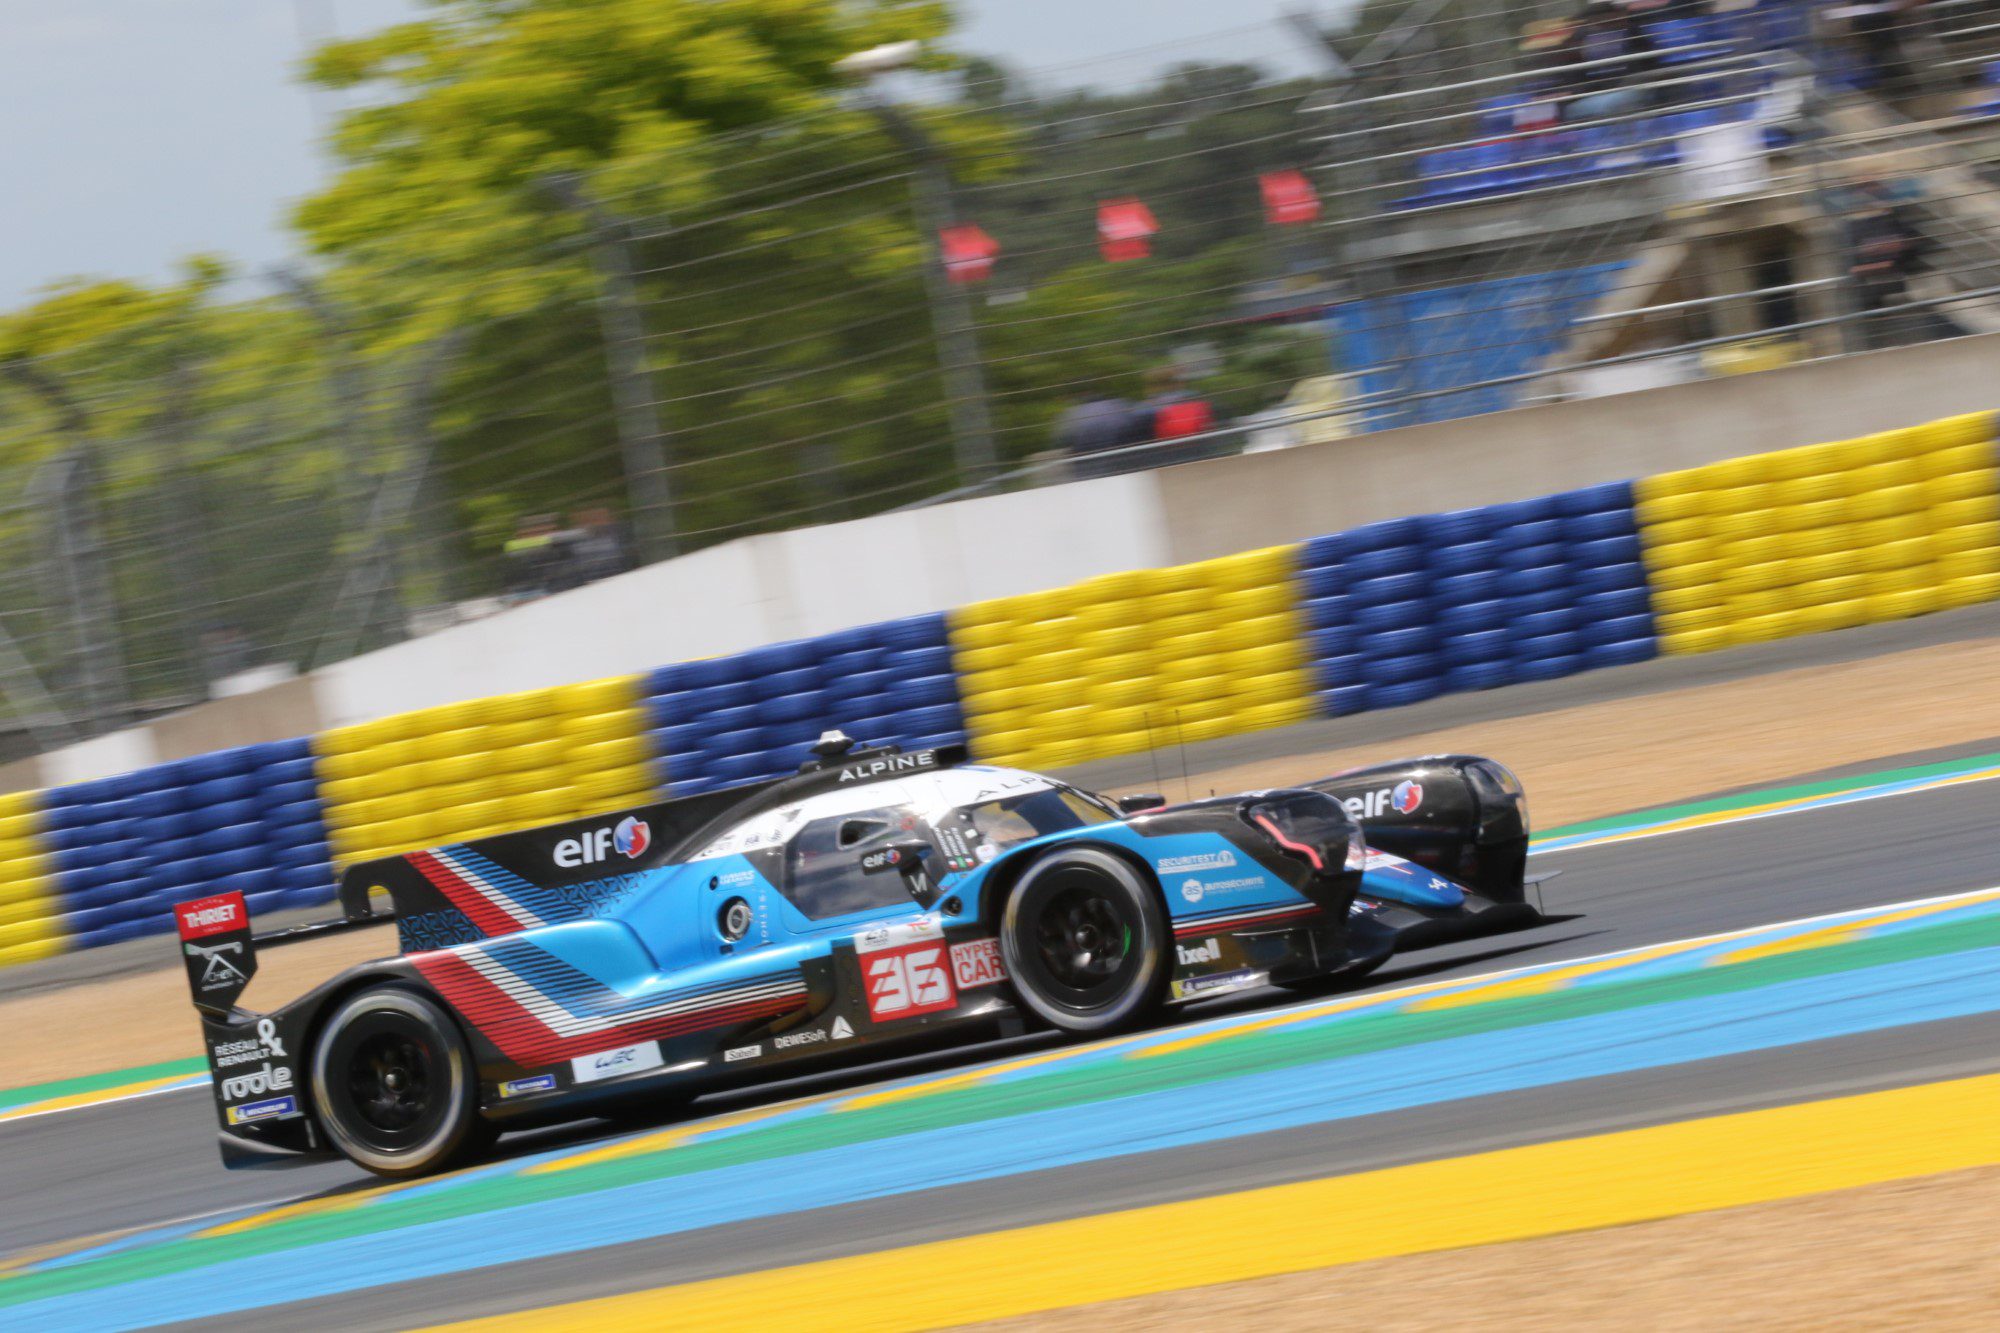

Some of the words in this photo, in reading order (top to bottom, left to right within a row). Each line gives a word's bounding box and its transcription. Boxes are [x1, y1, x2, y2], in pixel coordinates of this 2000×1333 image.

[839, 753, 934, 782] ALPINE
[974, 777, 1037, 803] ALP
[1343, 788, 1391, 820] elf
[553, 827, 613, 868] elf
[863, 852, 886, 868] elf
[183, 903, 237, 929] THIRIET
[954, 940, 999, 963] HYPER
[1176, 938, 1221, 965] ixell
[868, 948, 951, 1014] 36
[958, 955, 1006, 984] CAR
[221, 1062, 294, 1101] roole
